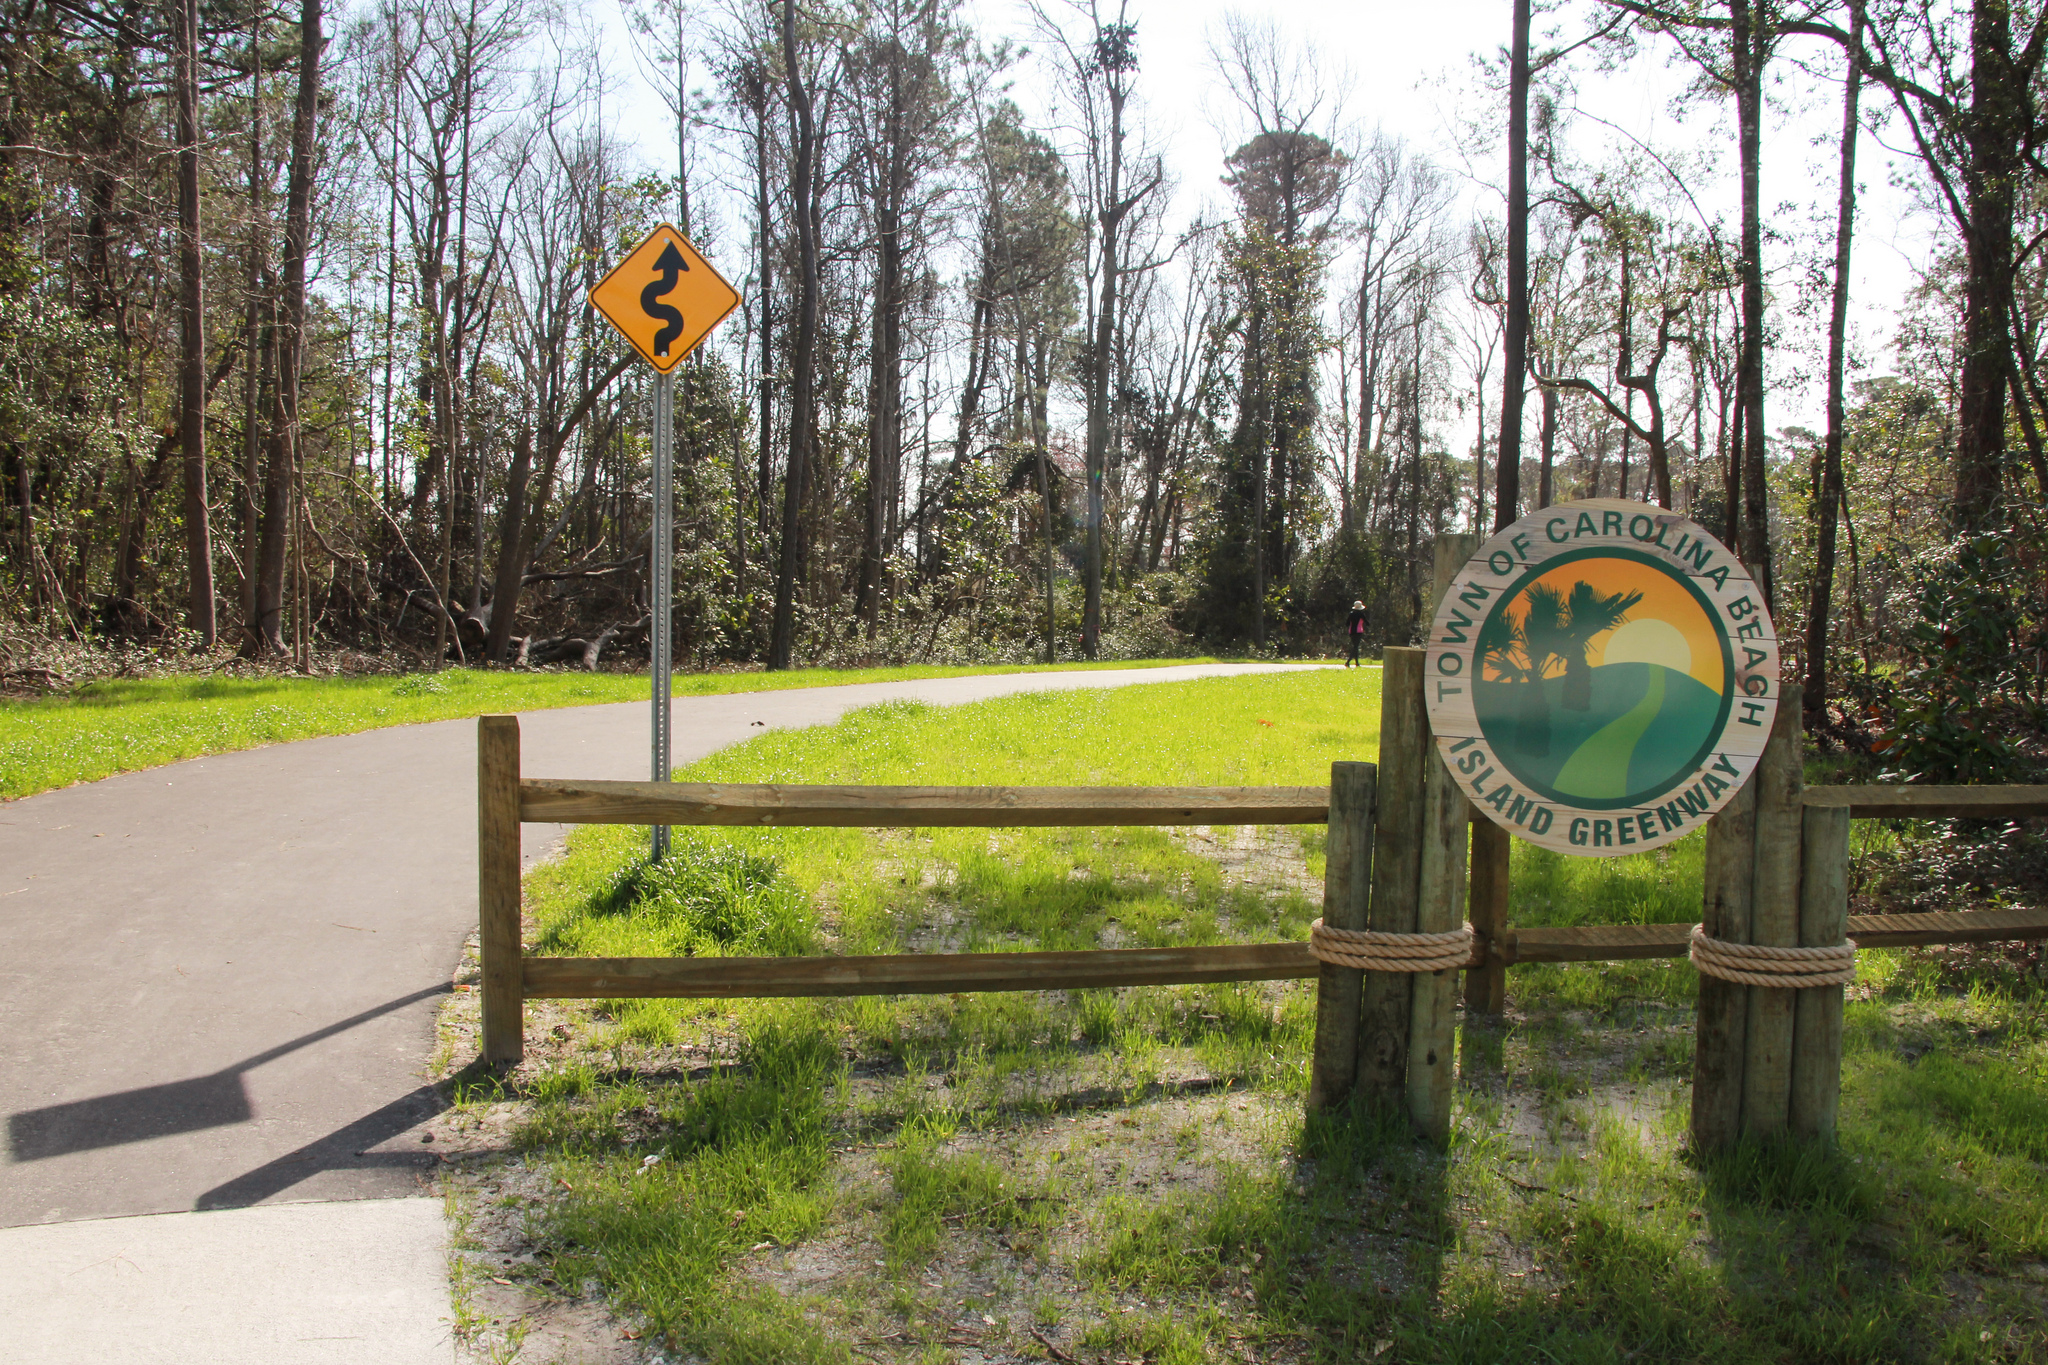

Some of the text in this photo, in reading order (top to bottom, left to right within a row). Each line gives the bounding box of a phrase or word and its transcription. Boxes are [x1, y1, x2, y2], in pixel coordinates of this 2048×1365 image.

[1437, 510, 1768, 727] TOWN OF CAROLINA BEACH
[1449, 736, 1740, 847] ISLAND GREENWAY
